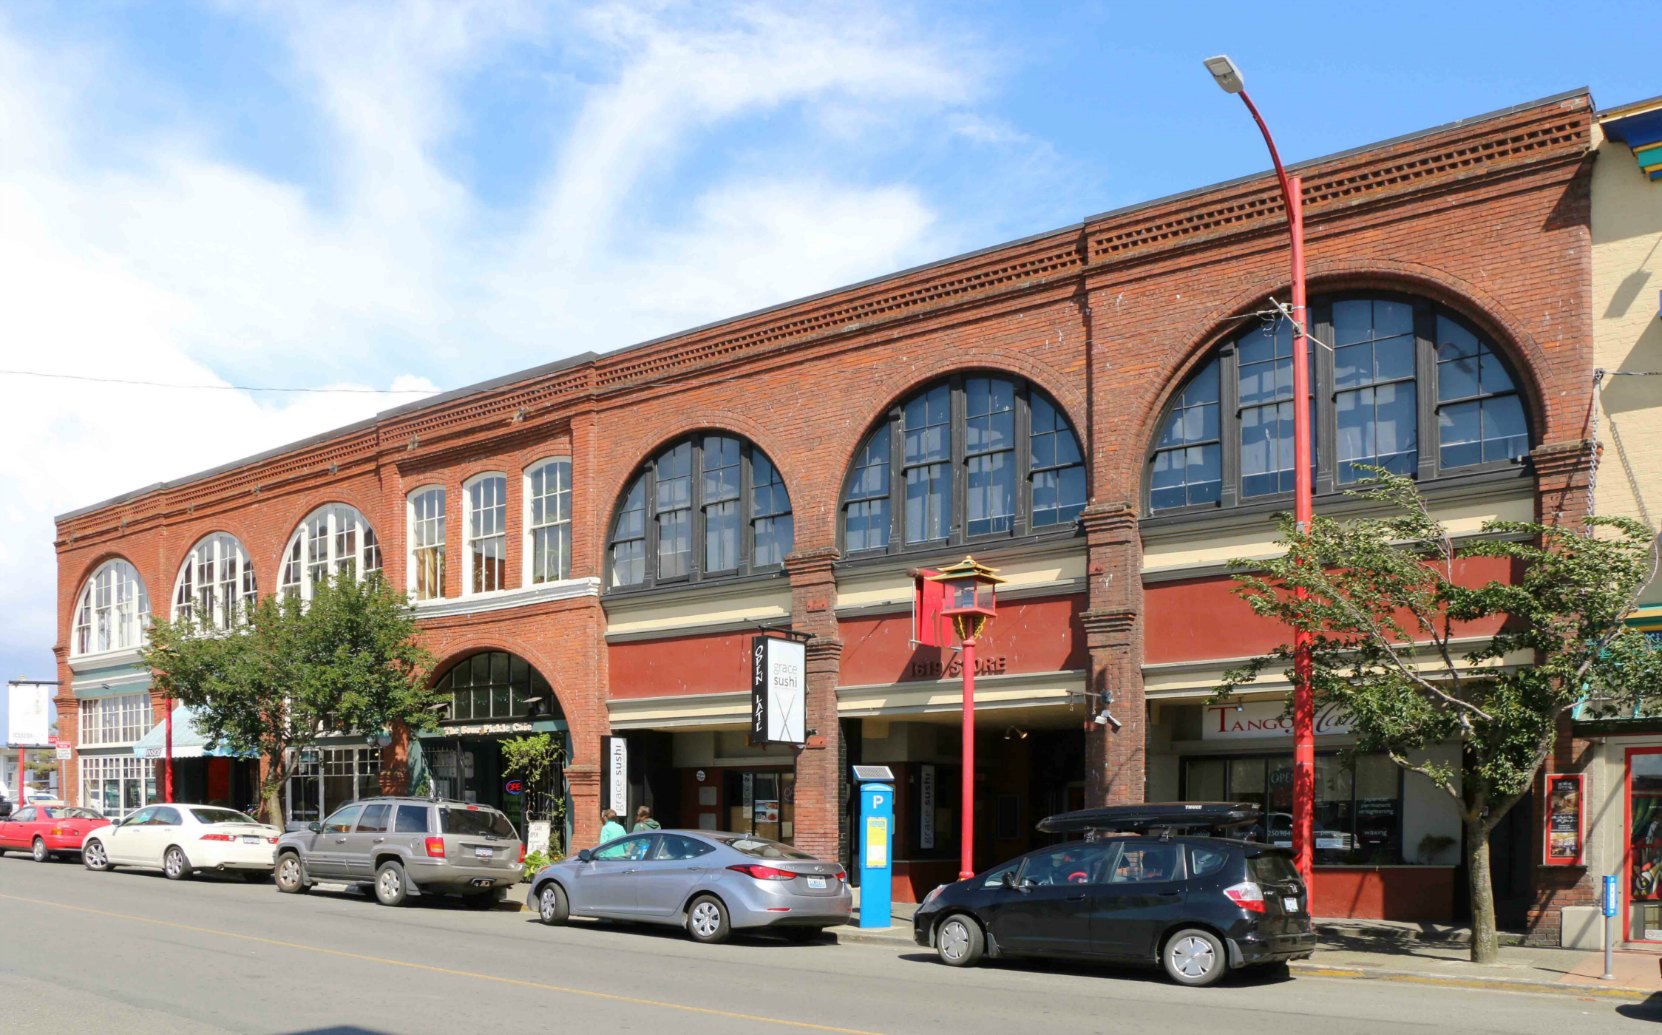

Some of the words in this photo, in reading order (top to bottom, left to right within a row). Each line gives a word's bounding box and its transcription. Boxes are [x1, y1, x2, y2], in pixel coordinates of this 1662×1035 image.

[754, 644, 764, 686] OPEN
[773, 662, 798, 675] grace
[949, 657, 1006, 677] SORE
[773, 675, 798, 688] sushi
[755, 694, 763, 732] LATE
[443, 726, 460, 735] The
[613, 745, 622, 776] sushi
[1270, 771, 1293, 784] OPE
[615, 780, 625, 812] grace
[872, 794, 884, 809] P
